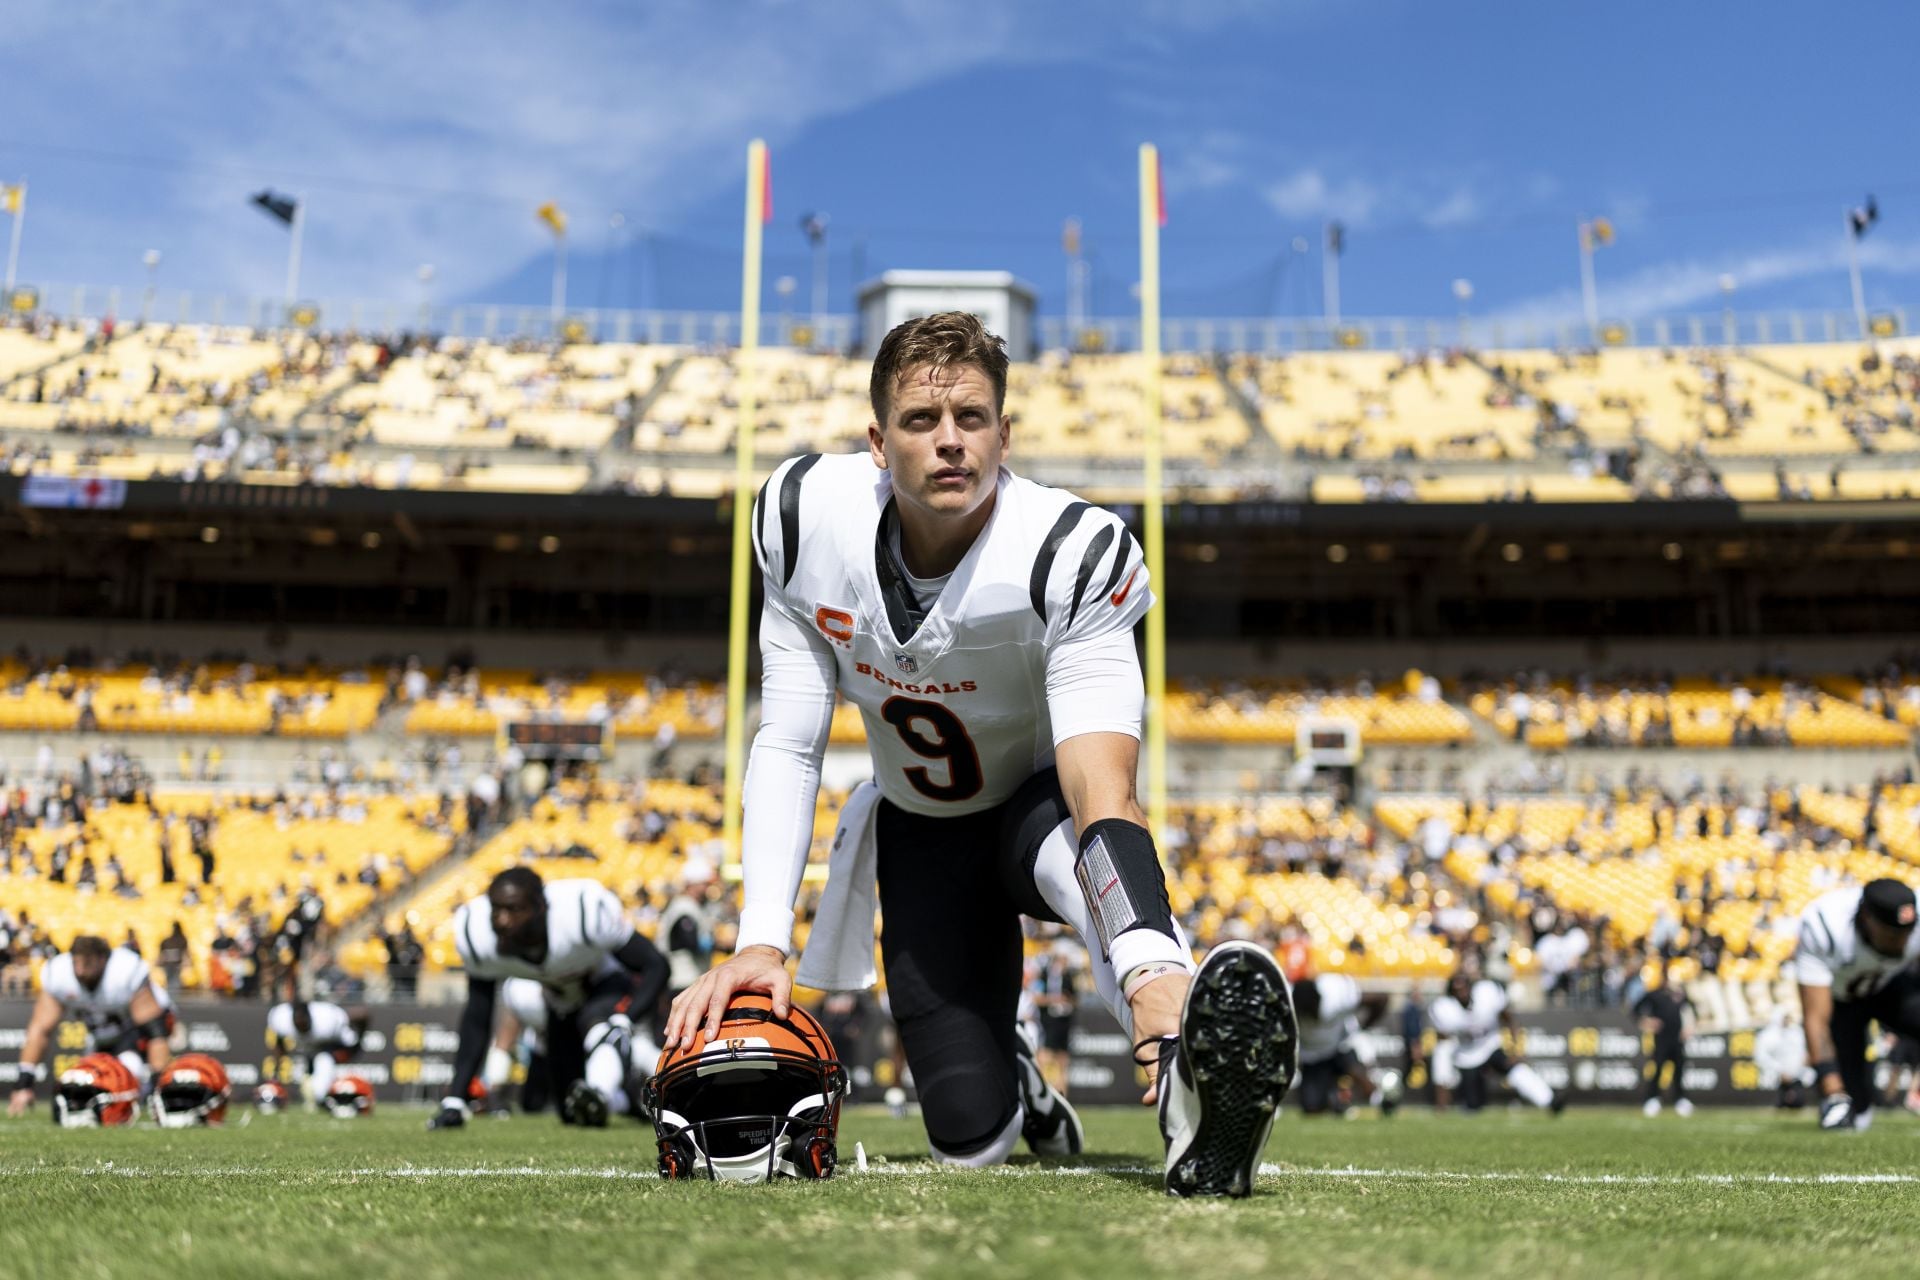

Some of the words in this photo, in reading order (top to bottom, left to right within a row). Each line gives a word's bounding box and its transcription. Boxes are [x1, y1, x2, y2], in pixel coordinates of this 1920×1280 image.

[815, 607, 854, 642] C
[855, 662, 978, 694] BENGALS
[881, 695, 985, 802] 9
[738, 1128, 776, 1139] SPEEDFLE
